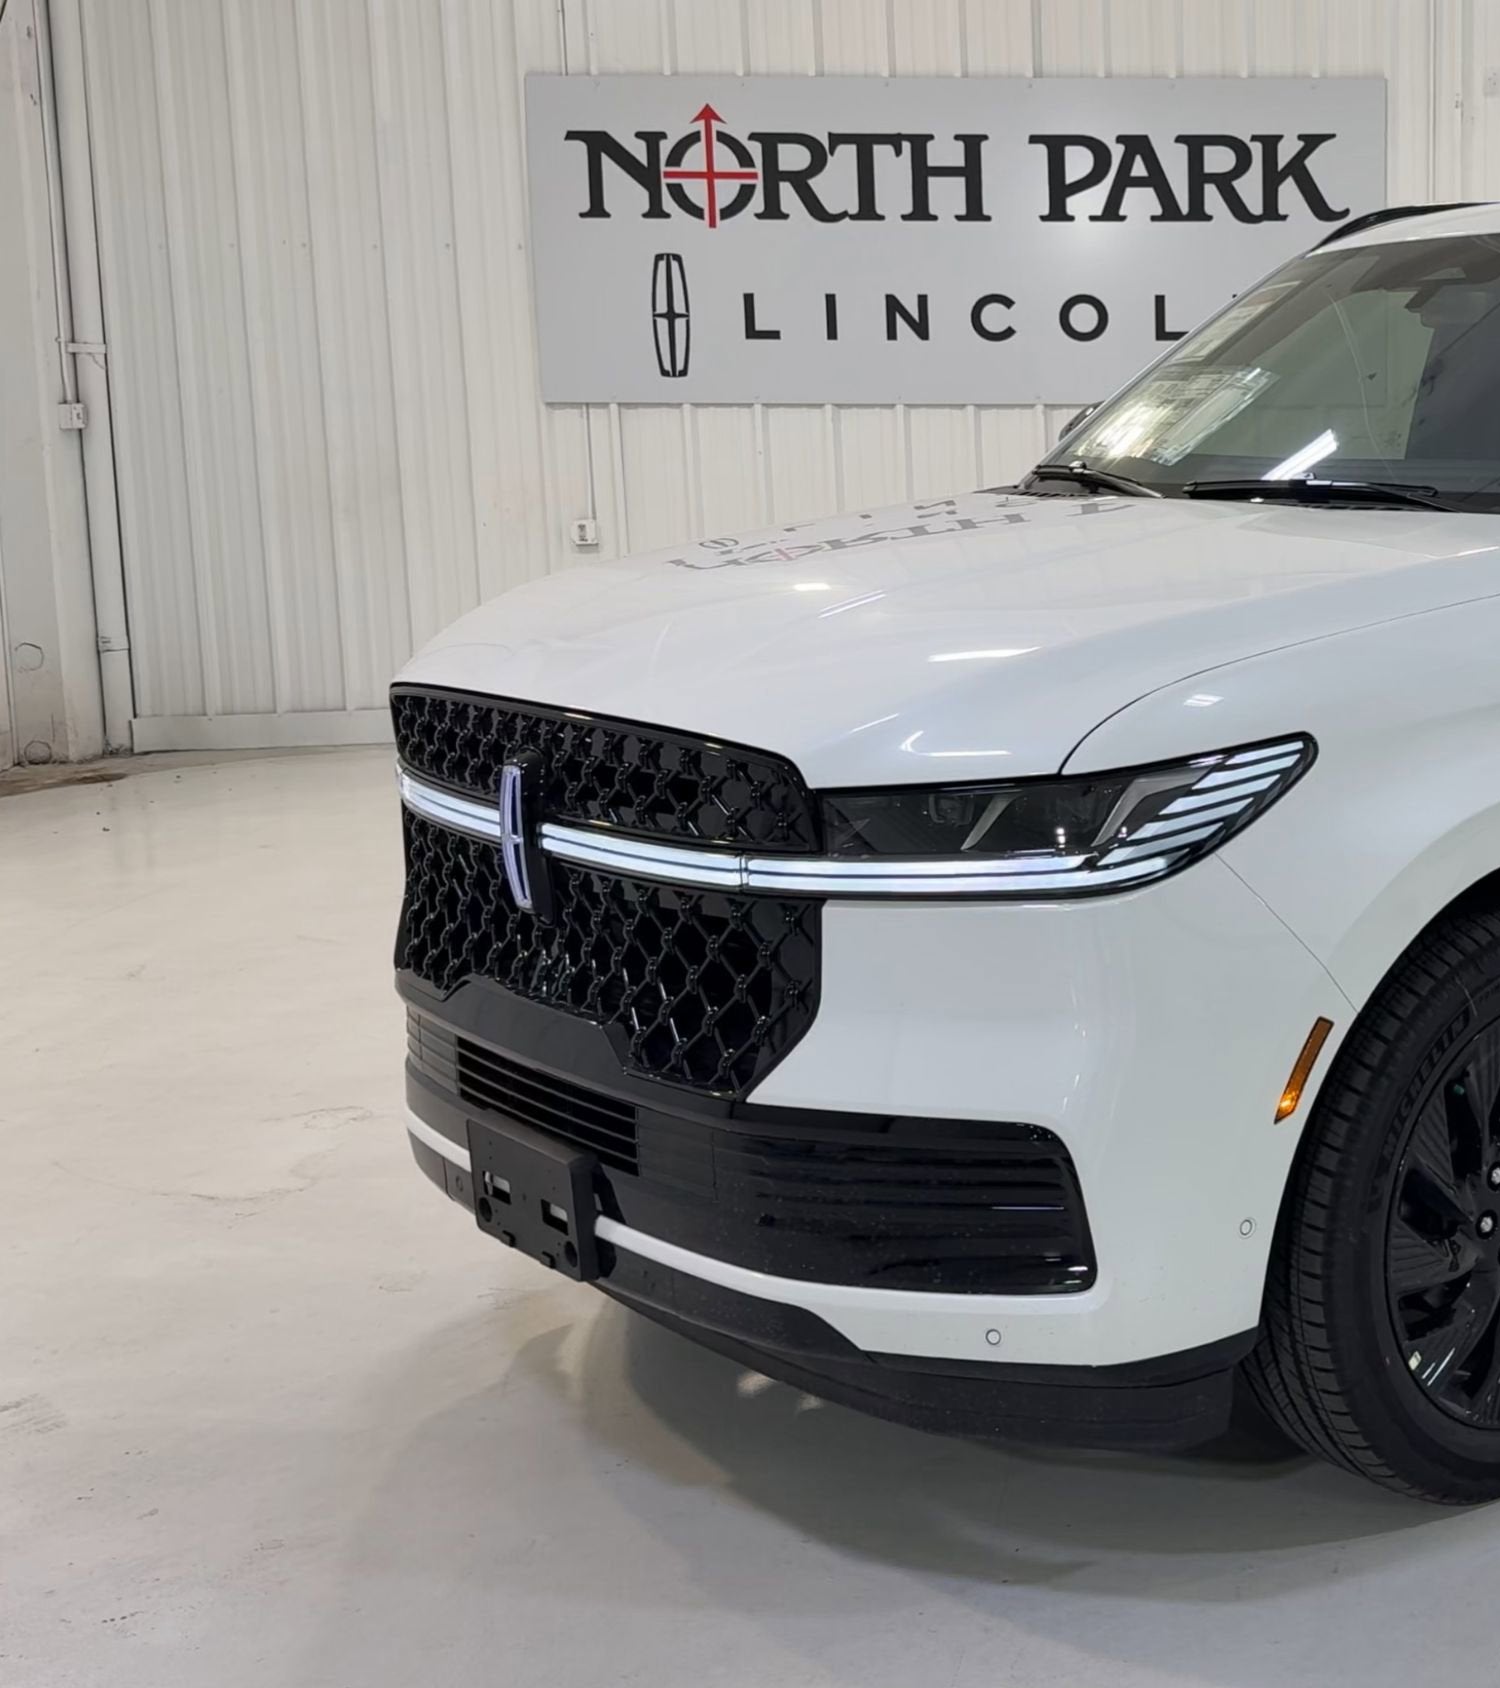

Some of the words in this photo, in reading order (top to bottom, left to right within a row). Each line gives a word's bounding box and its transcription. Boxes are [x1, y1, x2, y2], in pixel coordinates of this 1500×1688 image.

[564, 127, 992, 224] NORTH
[1029, 132, 1351, 225] PARK
[743, 293, 1237, 341] LINCOL
[1380, 1009, 1470, 1162] MICHELIN
